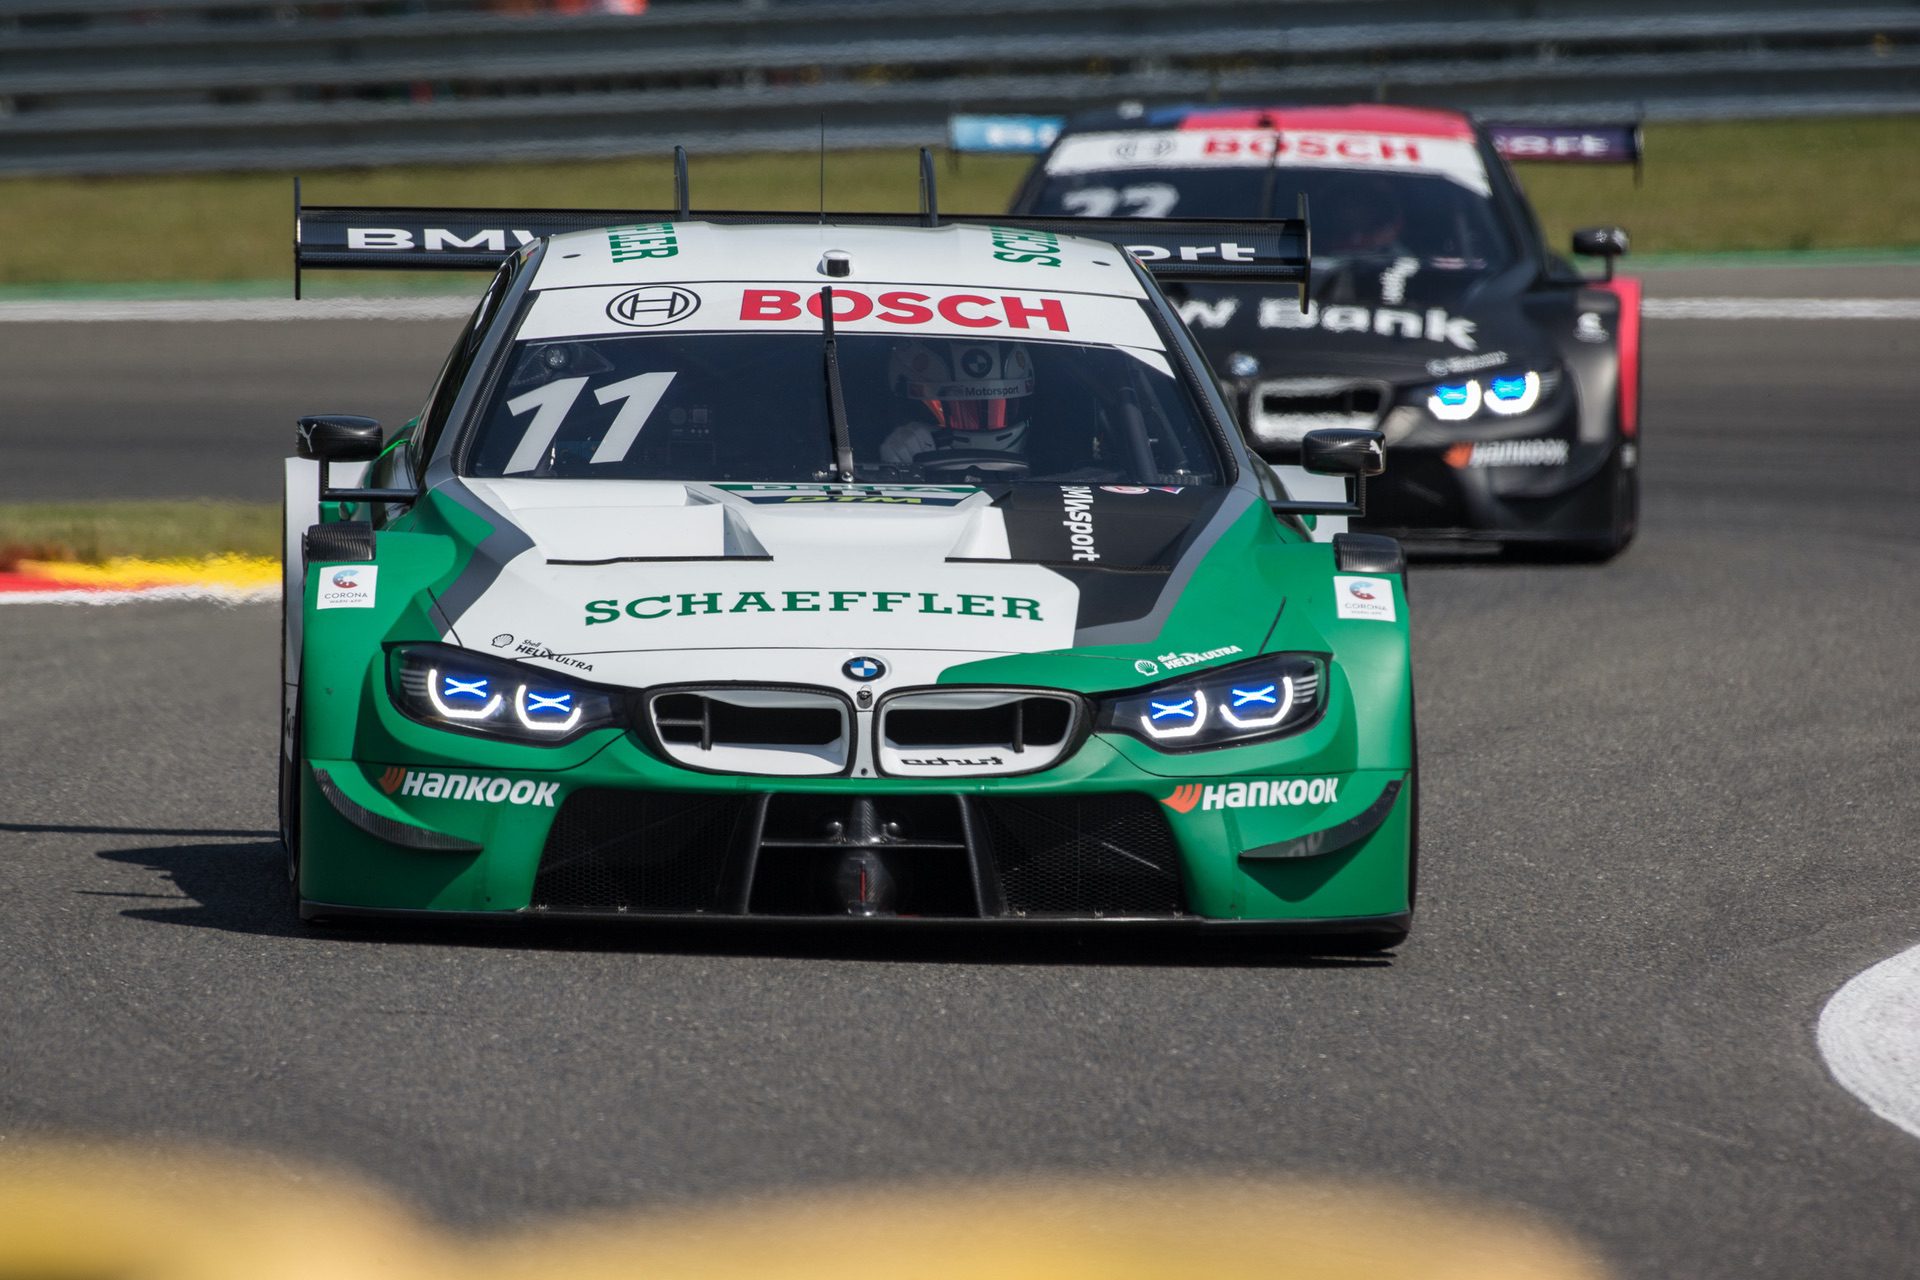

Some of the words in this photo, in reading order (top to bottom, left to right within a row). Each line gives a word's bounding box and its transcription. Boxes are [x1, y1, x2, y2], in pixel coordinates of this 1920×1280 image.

[1205, 138, 1421, 163] BOSCH
[740, 288, 1070, 333] BOSCH
[1257, 296, 1478, 350] Bank
[964, 385, 1020, 397] Motorsport
[502, 371, 677, 475] 11
[784, 495, 922, 504] DTM
[324, 592, 368, 600] CORONA
[584, 590, 1045, 627] SCHAEFFLER
[555, 653, 594, 672] ULTRA
